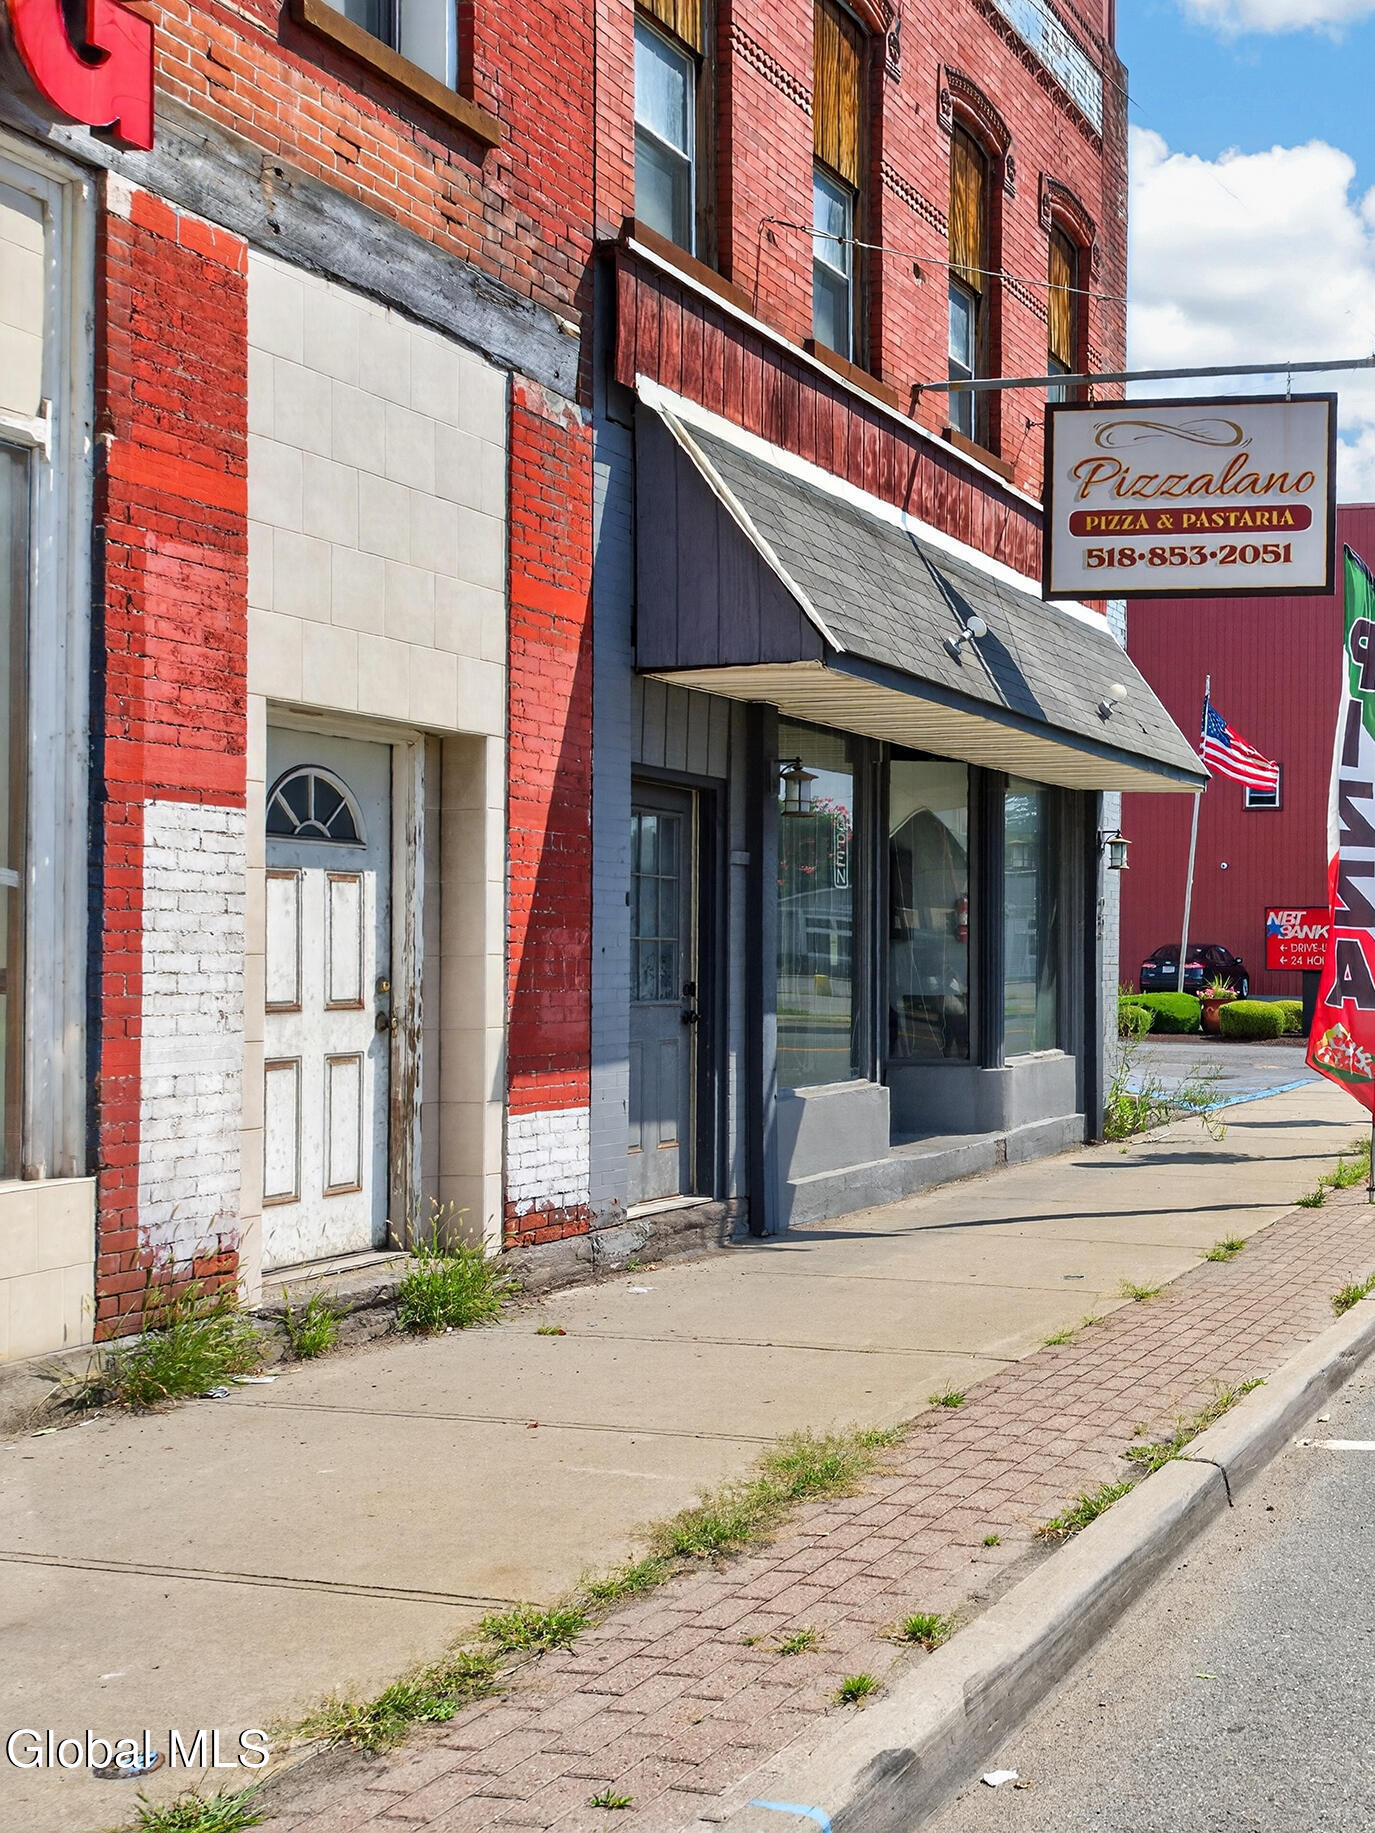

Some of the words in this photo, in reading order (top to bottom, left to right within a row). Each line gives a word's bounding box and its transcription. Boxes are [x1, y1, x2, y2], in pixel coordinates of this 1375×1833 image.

[1073, 453, 1316, 499] Pizzalano
[1085, 512, 1150, 531] PIZZA
[1156, 510, 1174, 529] &
[1182, 509, 1295, 528] PASTARIA
[1266, 911, 1307, 925] NBT
[1277, 925, 1330, 939] BANK
[1290, 943, 1328, 952] DRIVE-U
[1291, 956, 1303, 965] 24
